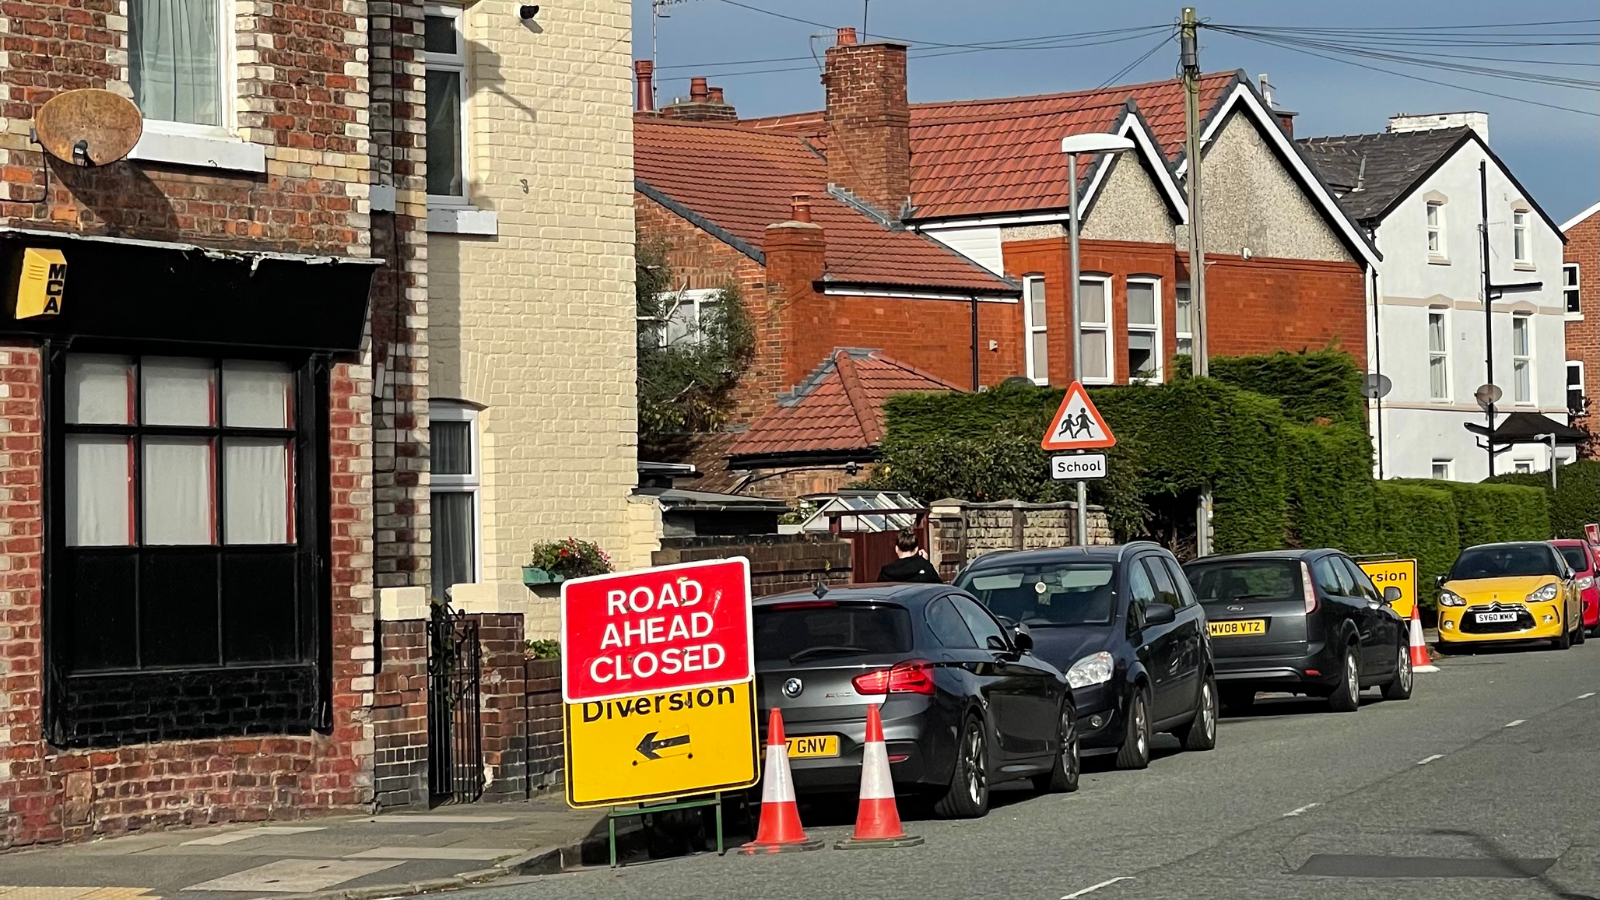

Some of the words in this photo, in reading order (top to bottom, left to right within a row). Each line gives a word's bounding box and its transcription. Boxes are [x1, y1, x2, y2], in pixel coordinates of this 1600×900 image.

[43, 263, 66, 313] MCA
[1057, 460, 1101, 473] School
[1369, 570, 1407, 582] rsion
[607, 579, 703, 616] ROAD
[600, 611, 714, 650] AHEAD
[1211, 623, 1238, 634] MV08
[1240, 622, 1261, 632] VTZ
[589, 643, 726, 683] CLOSED
[583, 685, 735, 723] Diversion
[797, 738, 827, 753] GNV
